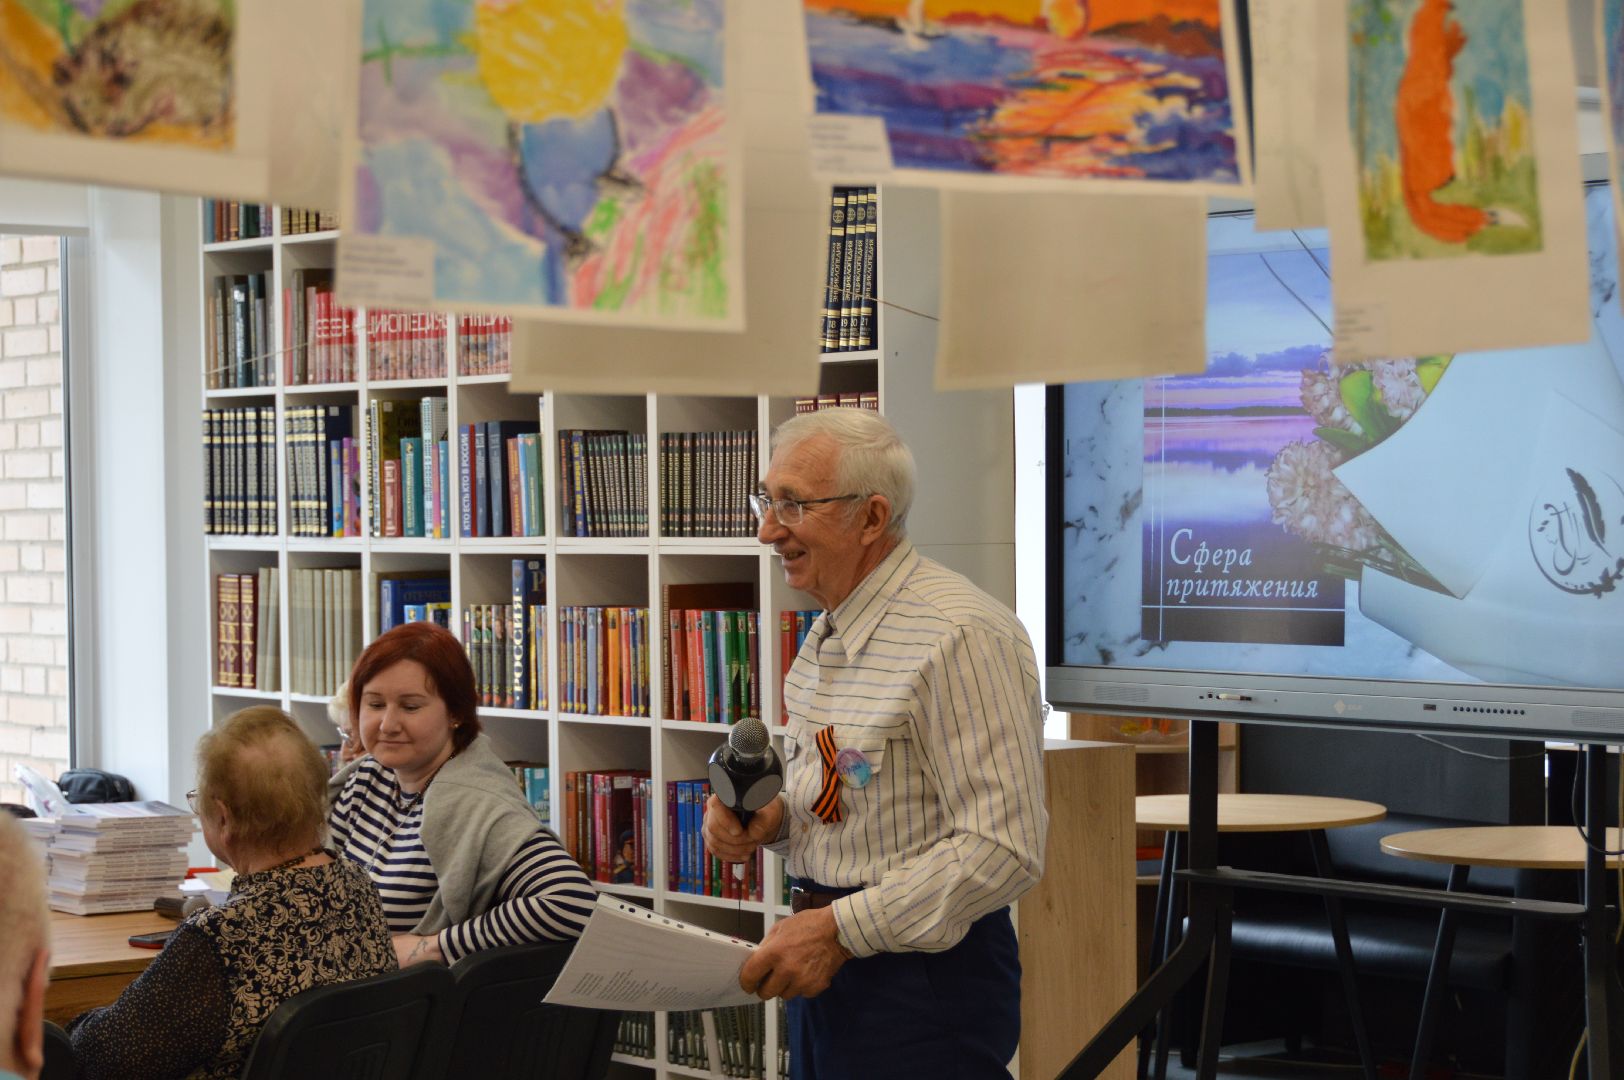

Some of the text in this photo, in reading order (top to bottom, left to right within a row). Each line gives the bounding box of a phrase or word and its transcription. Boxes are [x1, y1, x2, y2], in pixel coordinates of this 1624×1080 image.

[833, 243, 841, 302] ЭНЦИКЛОПЕДИЯ
[845, 240, 853, 301] ЭНЦИКЛОПЕДИЯ
[460, 433, 470, 467] РОССИИ
[462, 476, 470, 492] КТО
[463, 493, 471, 512] ЕСТЬ
[463, 513, 471, 531] КТО
[1170, 528, 1252, 573] Сфера
[1166, 578, 1319, 604] притяжения
[512, 595, 524, 691] РОССИЯ
